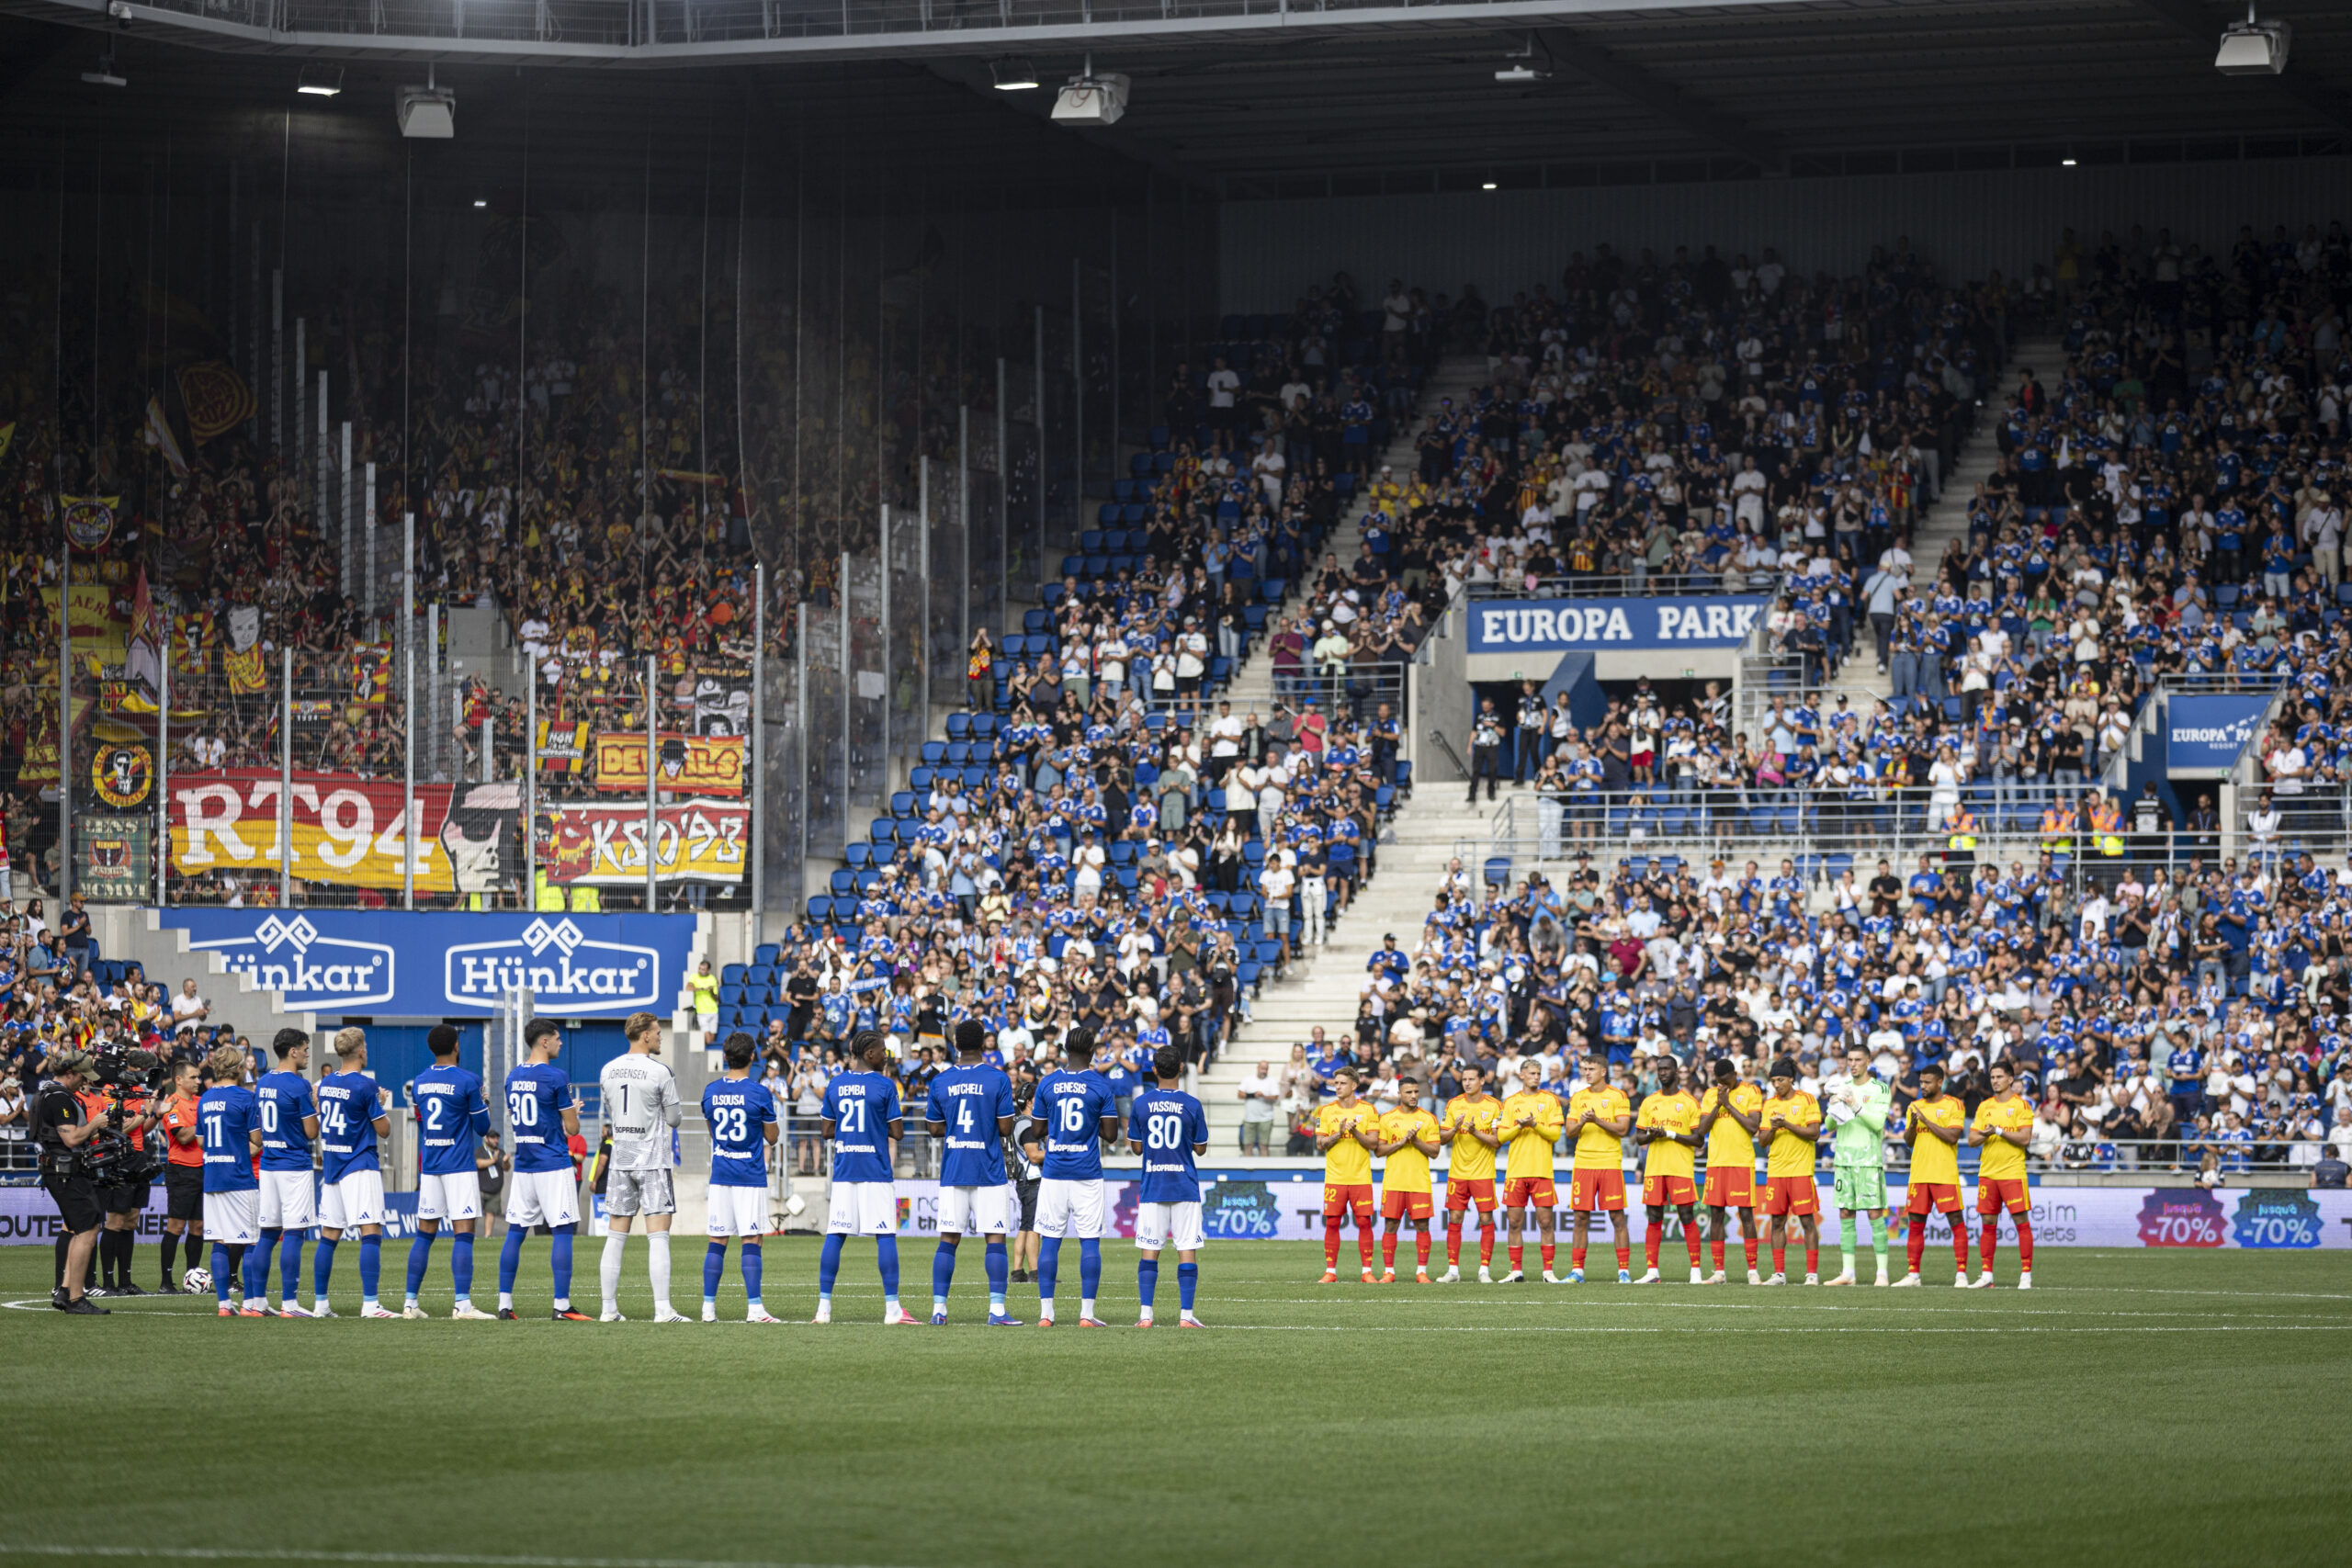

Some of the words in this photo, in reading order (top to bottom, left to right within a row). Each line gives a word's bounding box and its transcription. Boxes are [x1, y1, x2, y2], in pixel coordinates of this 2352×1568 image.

[1482, 607, 1633, 642] EUROPA
[1657, 604, 1758, 639] PARK
[2172, 728, 2227, 742] EUROPA
[2236, 728, 2253, 741] PA
[2209, 742, 2238, 750] RESORT
[591, 809, 744, 874] KSO'93
[461, 955, 639, 995] Hünkar
[510, 1080, 537, 1092] JACOBO
[620, 1083, 628, 1115] 1
[838, 1084, 865, 1097] DEMBA
[947, 1083, 985, 1097] MITCHELL
[1053, 1082, 1088, 1095] GENESIS
[202, 1100, 227, 1113] NANASI
[509, 1092, 538, 1126] 30
[712, 1094, 745, 1107] D.SOUSA
[1148, 1100, 1184, 1114] YASSINE
[258, 1100, 278, 1133] 10
[321, 1100, 348, 1136] 24
[426, 1097, 444, 1131] 2
[713, 1107, 748, 1142] 23
[839, 1098, 865, 1133] 21
[956, 1099, 975, 1134] 4
[1057, 1097, 1085, 1133] 16
[1651, 1117, 1683, 1129] Auchan
[204, 1114, 223, 1148] 11
[615, 1126, 646, 1134] SOPREMA
[1148, 1114, 1182, 1150] 80
[1152, 1164, 1185, 1173] SOPREMA
[1324, 1187, 1337, 1202] 22
[1504, 1178, 1517, 1192] 27
[1208, 1210, 1272, 1235] -70%
[2004, 1224, 2076, 1242] otlets
[2147, 1217, 2218, 1244] -70%
[2242, 1217, 2313, 1245] -70%
